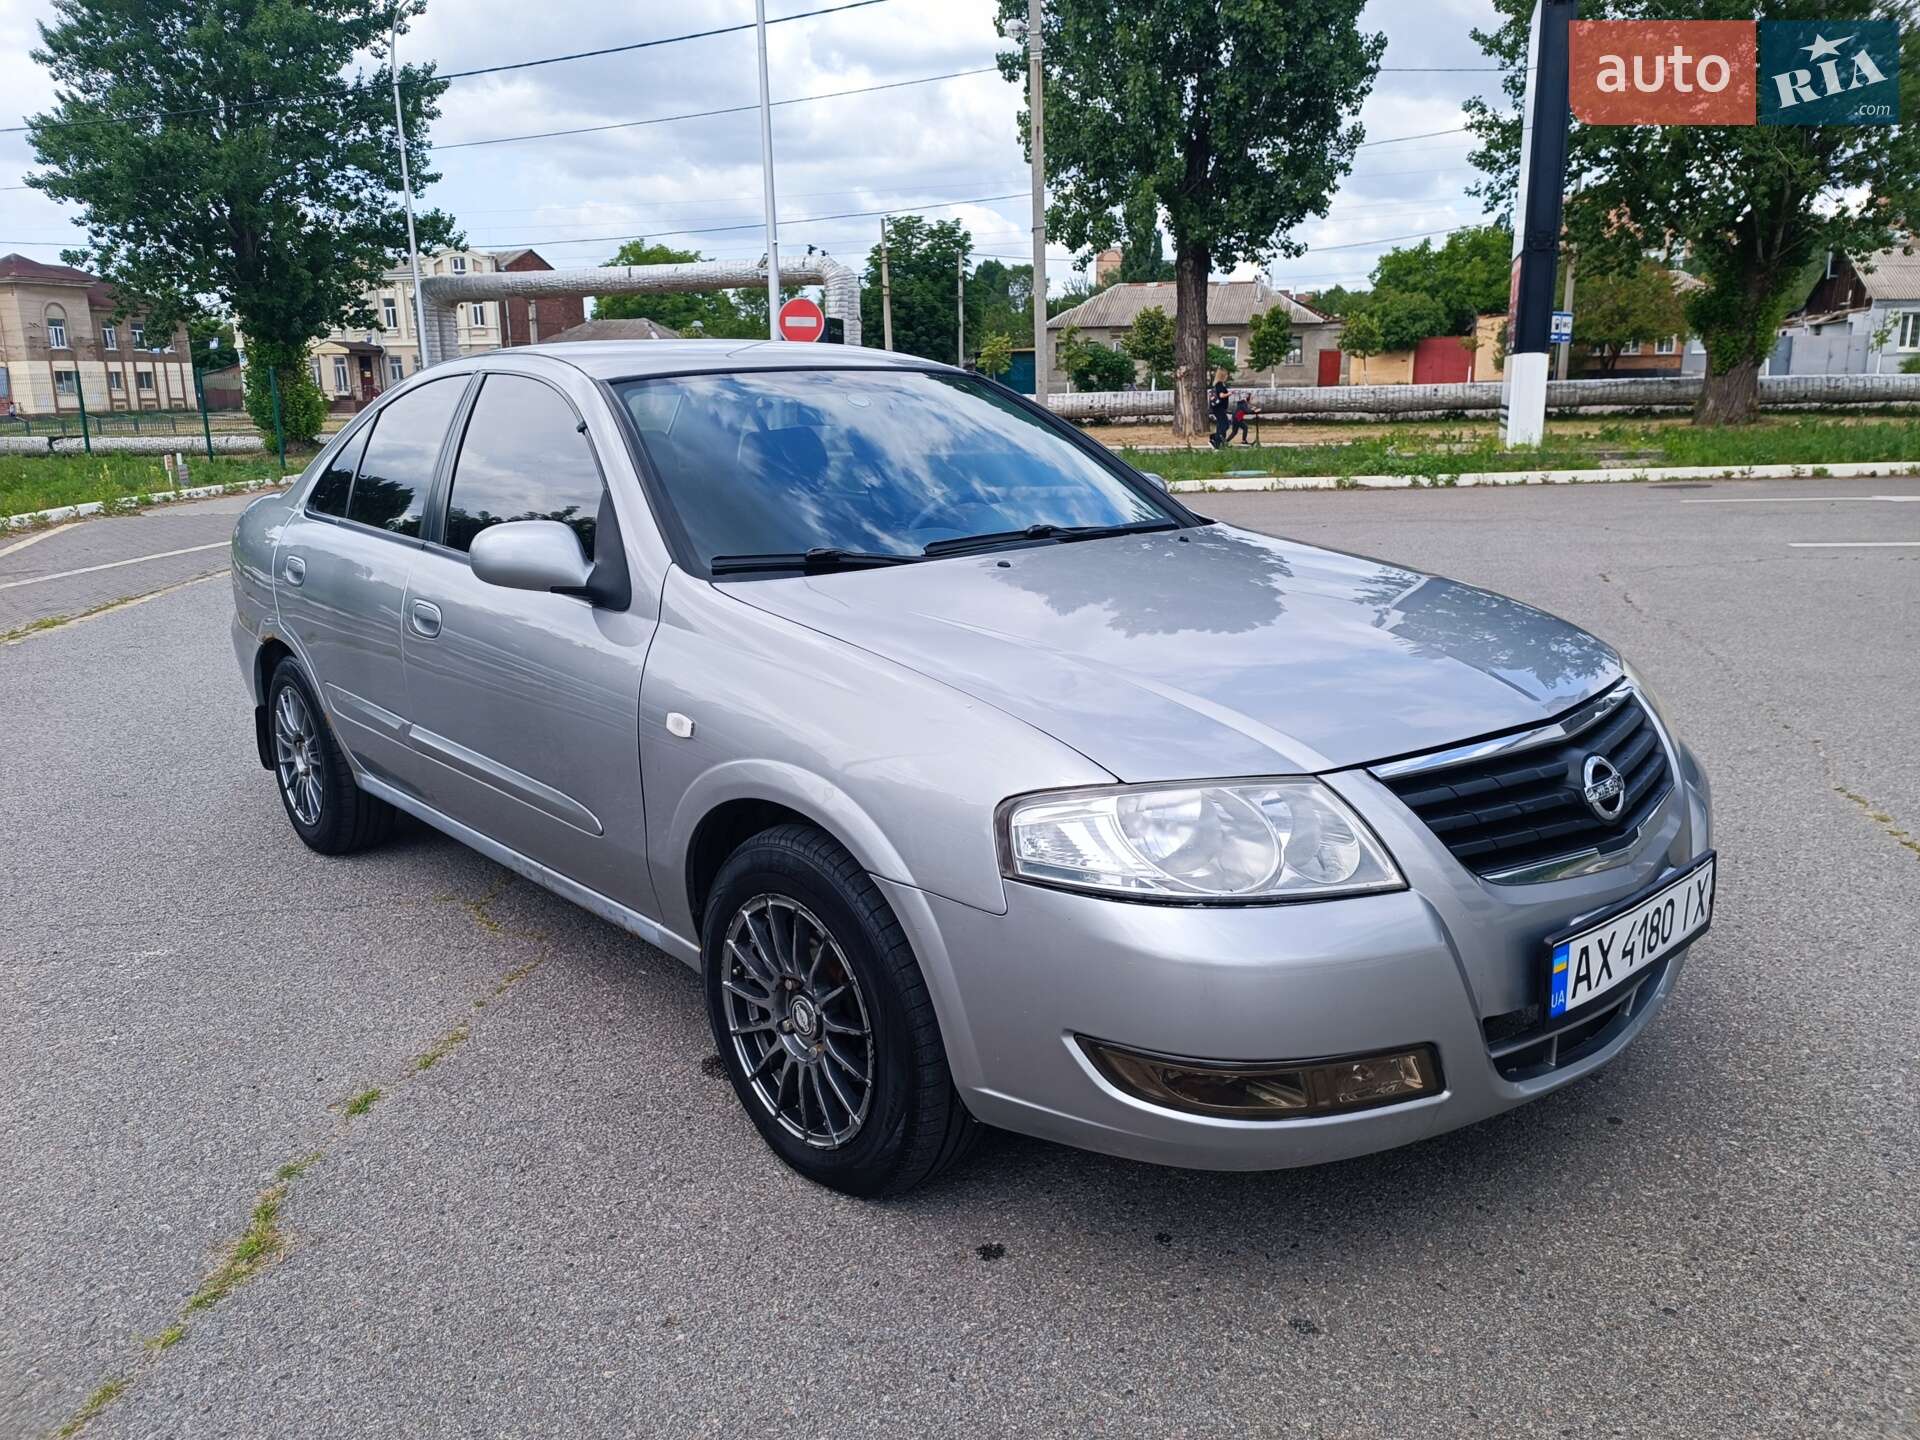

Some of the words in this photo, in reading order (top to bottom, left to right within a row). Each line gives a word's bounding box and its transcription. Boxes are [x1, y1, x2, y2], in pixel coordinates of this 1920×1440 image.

[1571, 932, 1616, 999] AX
[1622, 898, 1675, 967] 4180
[1551, 990, 1565, 1008] UA
